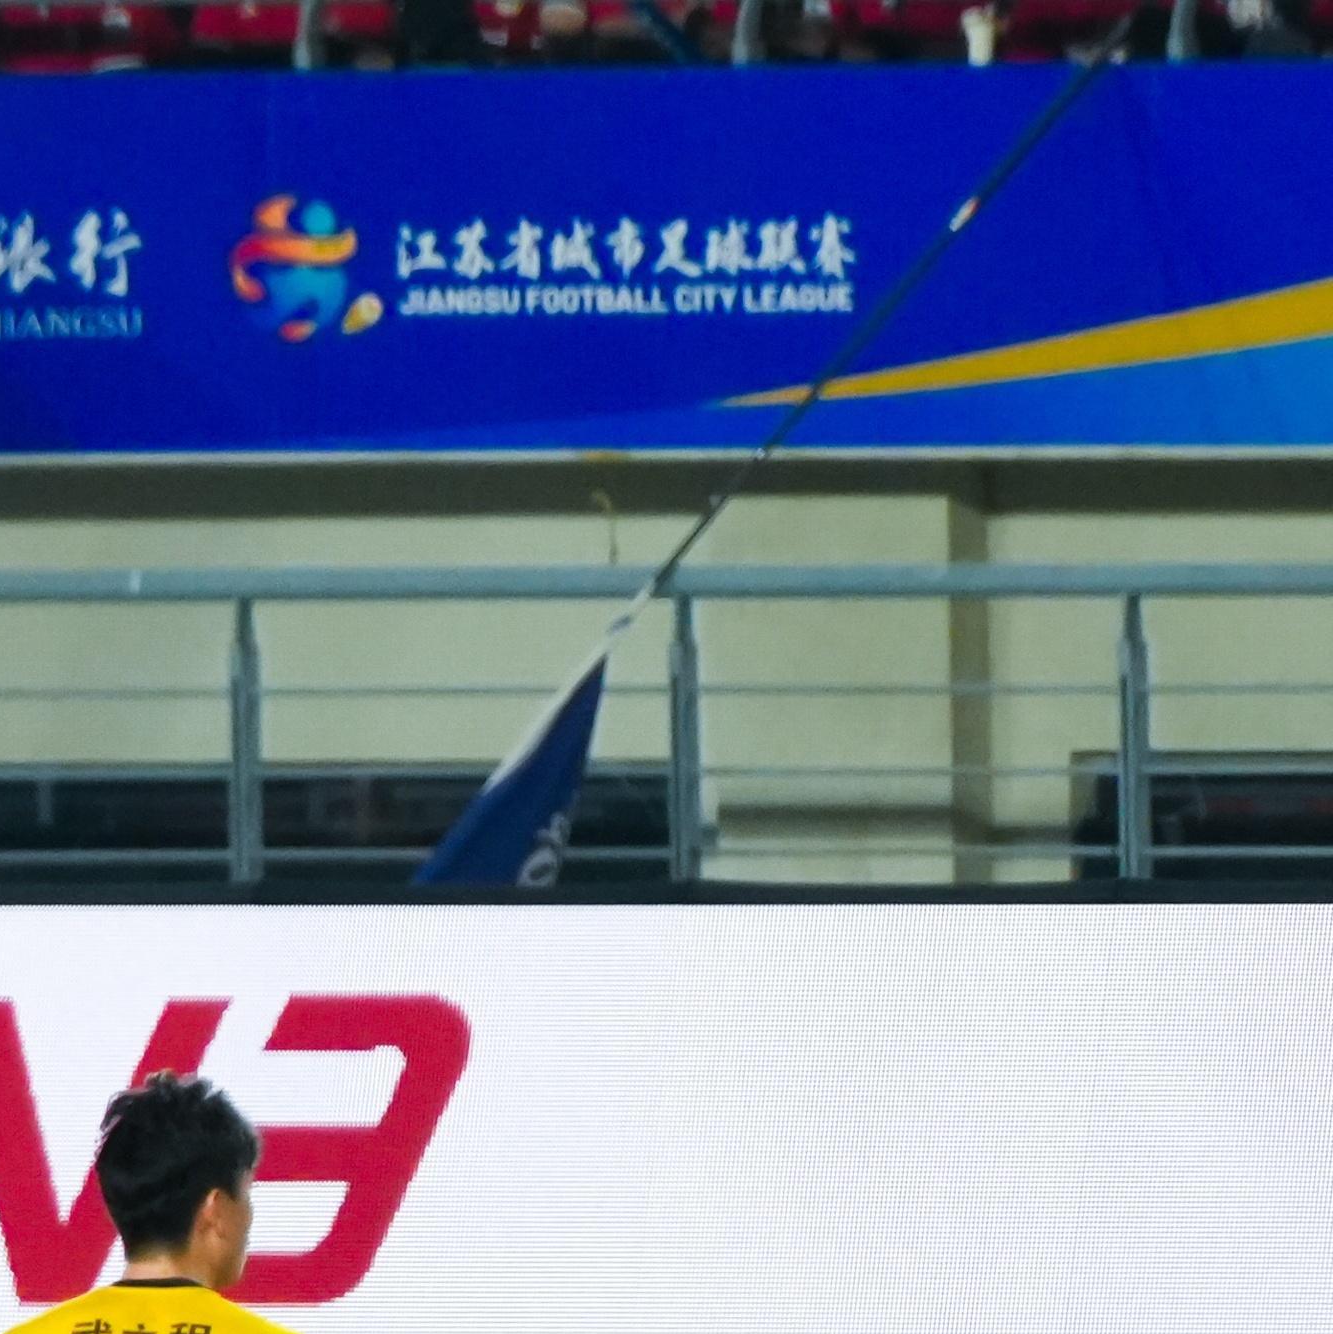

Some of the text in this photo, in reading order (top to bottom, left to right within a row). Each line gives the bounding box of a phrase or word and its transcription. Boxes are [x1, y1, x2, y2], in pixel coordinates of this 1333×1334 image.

[397, 212, 855, 278] 江苏省城市足球联赛
[399, 285, 854, 314] JIANGSU FOOTBALL CITY LEAGUE
